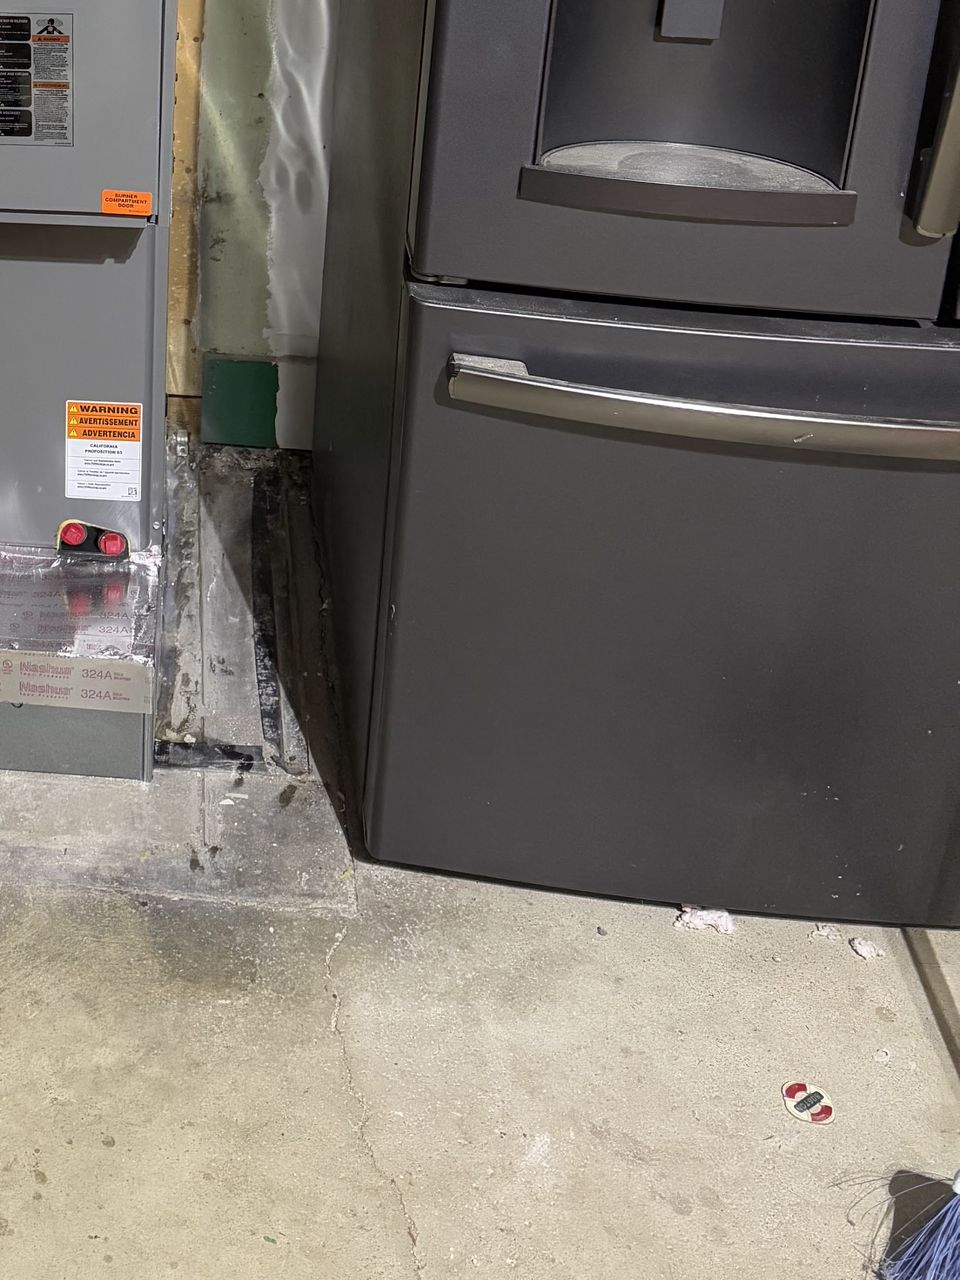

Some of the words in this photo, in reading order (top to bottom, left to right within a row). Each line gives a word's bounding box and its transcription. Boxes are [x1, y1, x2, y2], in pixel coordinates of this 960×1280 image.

[79, 405, 139, 415] WARNING
[78, 417, 139, 427] AVERTISSEMENT
[81, 429, 136, 439] ADVERTENCIA
[98, 625, 129, 634] 324A
[19, 660, 73, 675] Nashua
[81, 668, 113, 681] 324A
[19, 680, 72, 695] Nashua
[80, 689, 112, 701] 324A
